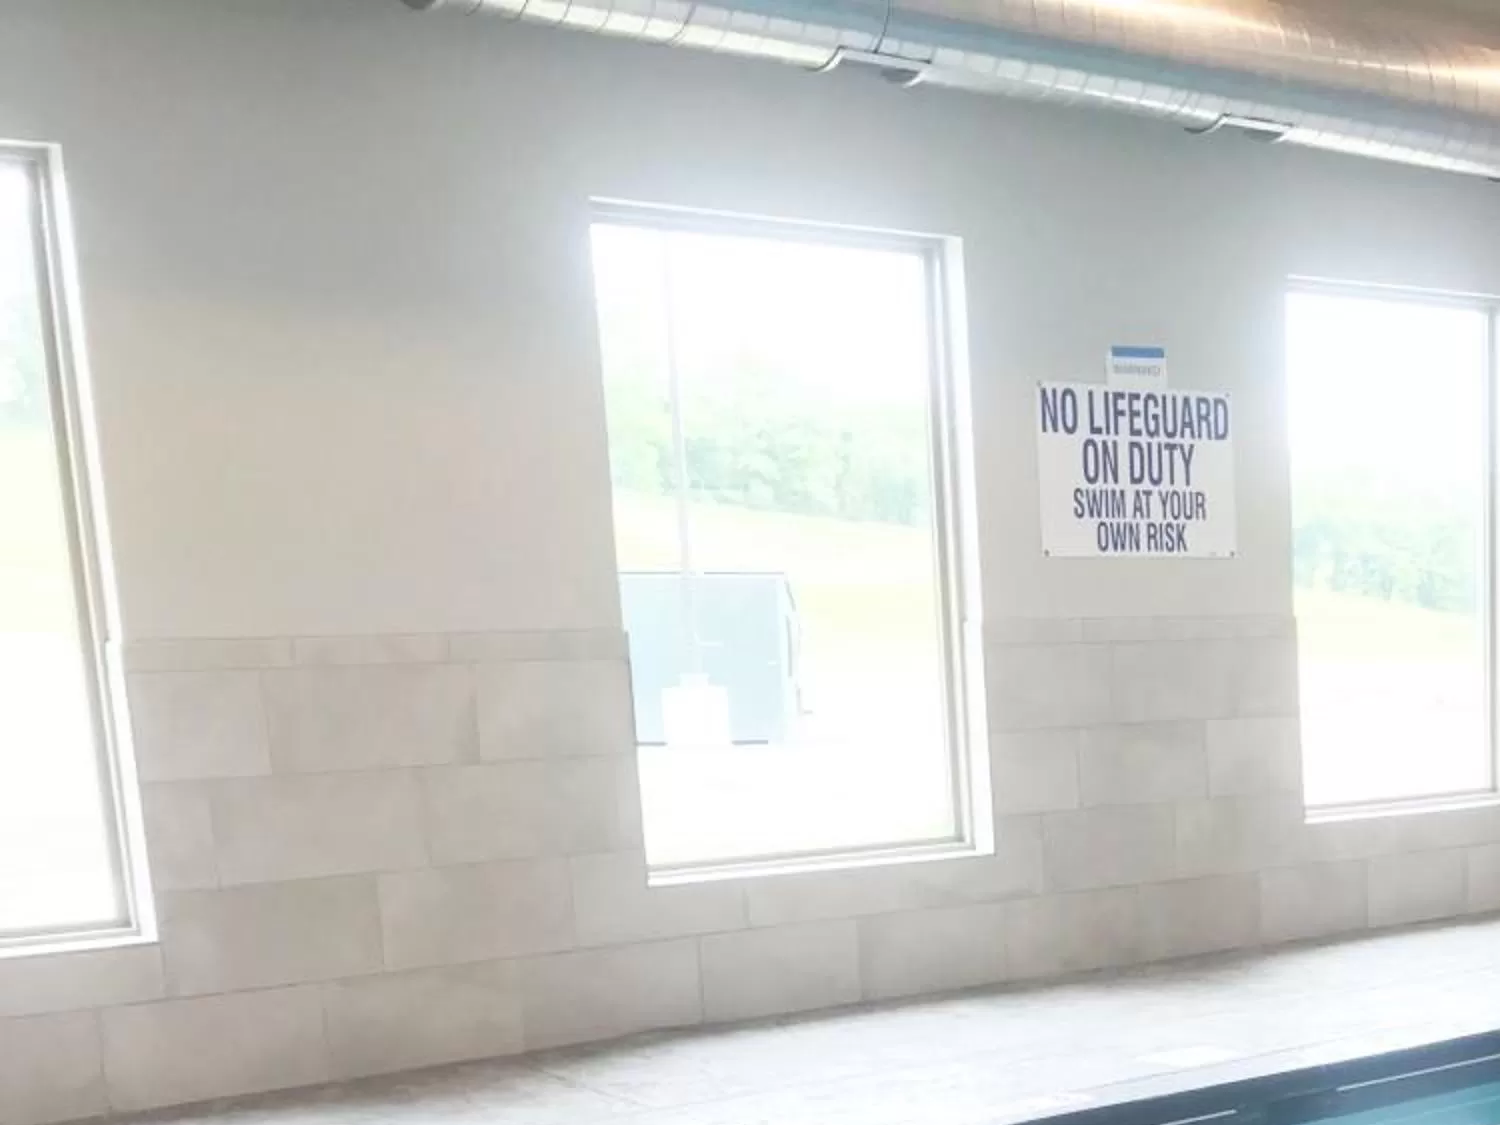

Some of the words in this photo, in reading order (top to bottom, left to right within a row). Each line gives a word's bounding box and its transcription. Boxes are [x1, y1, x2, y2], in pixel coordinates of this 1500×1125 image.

[1040, 387, 1079, 435] NO
[1088, 389, 1229, 441] LIFEGUARD
[1082, 438, 1119, 485] ON
[1127, 441, 1195, 487] DUTY
[1073, 487, 1127, 520] SWIM
[1133, 489, 1153, 520] AT
[1158, 490, 1207, 521] YOUR
[1097, 521, 1141, 553] OWN
[1147, 522, 1189, 553] RISK
